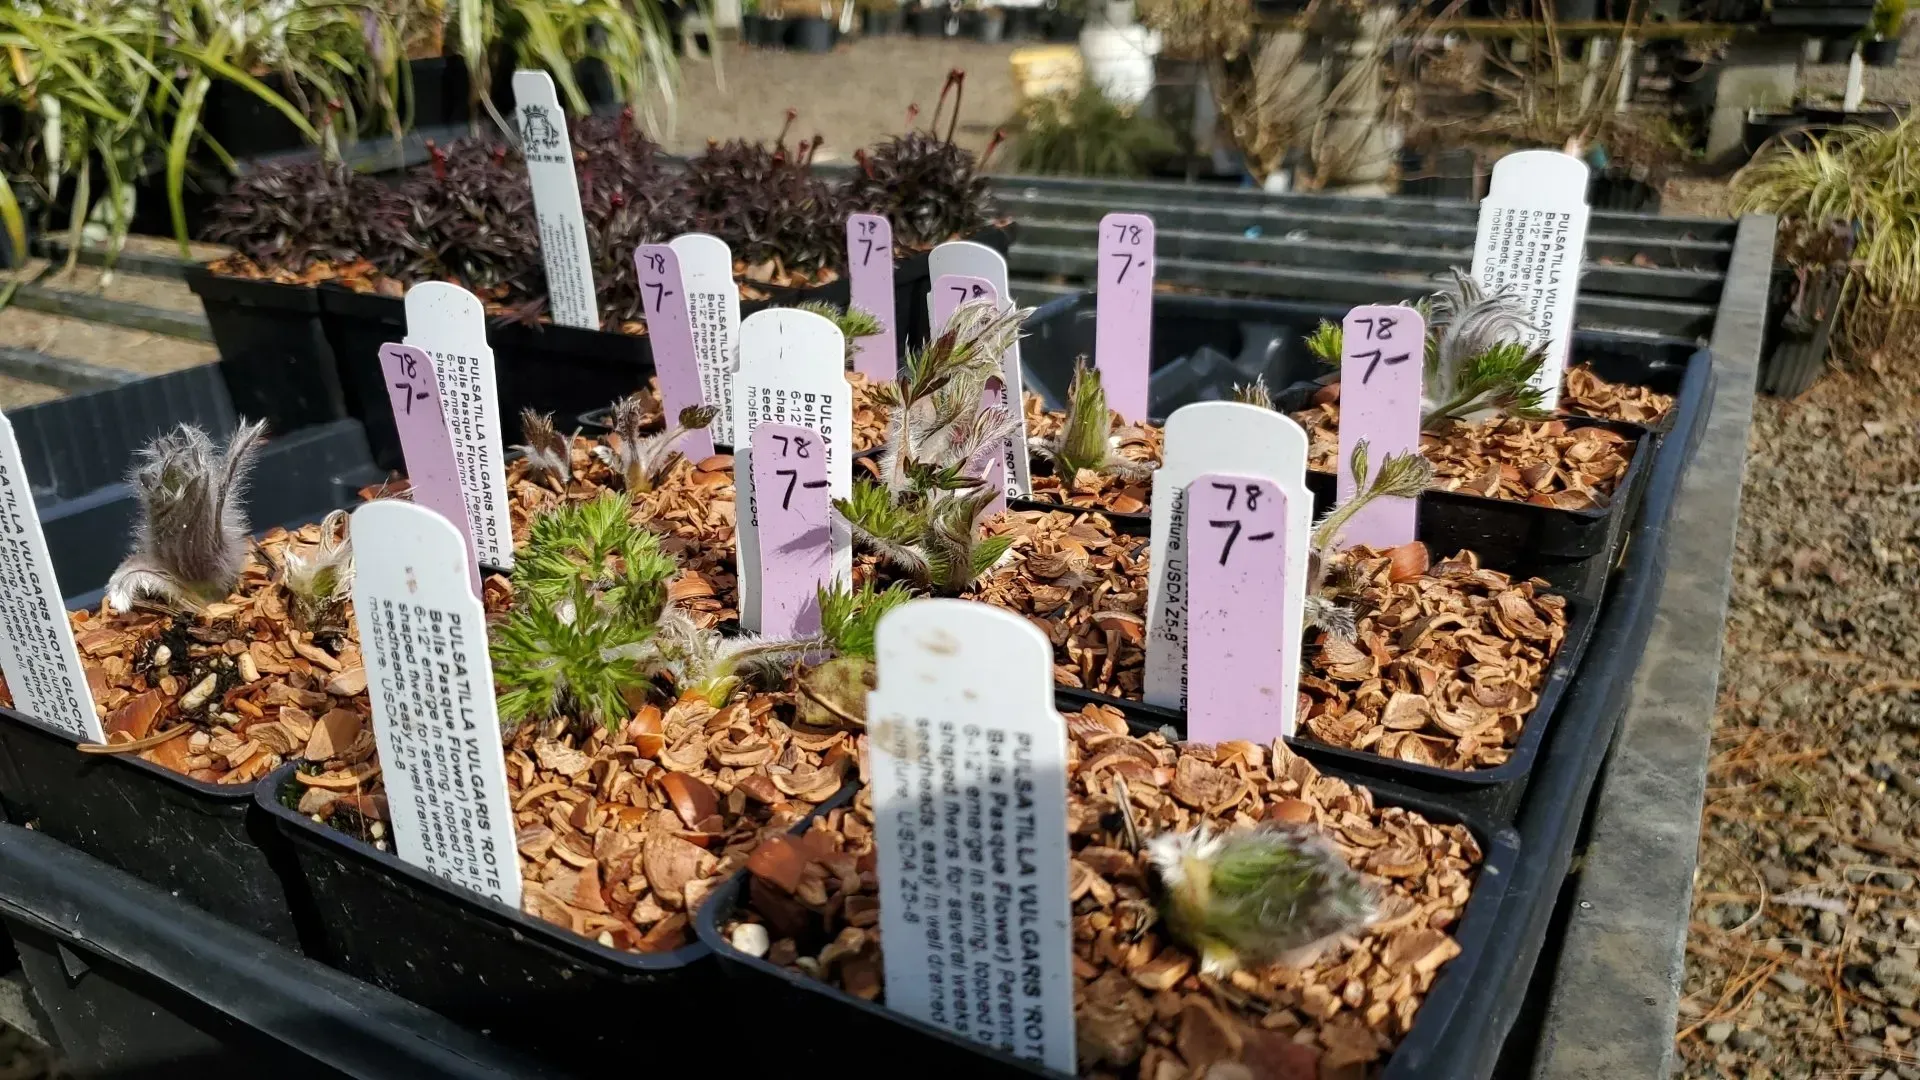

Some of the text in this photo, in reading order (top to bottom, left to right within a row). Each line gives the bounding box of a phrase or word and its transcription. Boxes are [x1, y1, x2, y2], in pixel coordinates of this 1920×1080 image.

[858, 221, 877, 235] 78
[1112, 224, 1142, 245] 78
[1514, 209, 1529, 247] shaped
[1541, 212, 1555, 240] Bells
[643, 254, 664, 274] 78
[1521, 241, 1536, 280] emerge
[1534, 243, 1550, 285] Pasque
[1548, 213, 1570, 284] PULSATILLA
[1482, 257, 1495, 288] USDA
[1494, 269, 1504, 290] eas
[1520, 282, 1530, 292] in
[689, 292, 698, 328] shaped
[707, 293, 716, 321] Bells
[717, 293, 729, 363] PULSATILLA
[1354, 317, 1398, 340] 78
[700, 322, 709, 360] emerge
[709, 324, 717, 364] Pasque
[390, 352, 417, 379] 78
[435, 352, 447, 395] shaped
[457, 355, 468, 388] Bells
[703, 362, 710, 371] in
[450, 389, 461, 435] emerge
[722, 366, 732, 422] VULGARIS
[774, 389, 787, 425] shap
[460, 392, 471, 441] Pasque
[455, 437, 464, 448] in
[469, 357, 485, 440] PULSATILLA
[478, 445, 493, 511] VULGARIS
[486, 515, 498, 553] 'ROTE
[772, 434, 810, 459] 78
[465, 444, 479, 491] Flower)
[1211, 482, 1263, 512] 78
[471, 495, 486, 549] Perennial
[1166, 559, 1181, 603] USDA
[19, 540, 51, 621] VULGARIS
[46, 626, 67, 672] 'ROTE
[1163, 607, 1179, 641] Z5-8
[7, 538, 32, 596] Flower)
[26, 600, 54, 665] Perennial
[48, 668, 68, 713] clumps
[63, 716, 76, 731] of
[398, 603, 417, 664] shaped
[429, 610, 446, 655] Bells
[15, 596, 37, 642] topped
[30, 644, 42, 662] by
[37, 664, 53, 697] hairy
[49, 699, 63, 722] red
[22, 674, 35, 698] sun
[31, 700, 40, 713] to
[25, 655, 47, 708] feathery
[421, 657, 439, 720] emerge
[436, 661, 455, 730] Pasque
[381, 678, 398, 727] USDA
[390, 732, 405, 770] Z5-8
[398, 701, 412, 740] easy
[416, 722, 429, 745] for
[431, 724, 443, 739] in
[406, 745, 417, 758] in
[447, 735, 469, 802] Flower)
[448, 613, 475, 730] PULSATILLA
[465, 738, 490, 829] VULGARIS
[480, 836, 500, 889] 'ROTE
[937, 722, 959, 796] shaped
[987, 730, 1004, 785] Bells
[409, 763, 424, 792] well
[421, 749, 440, 807] several
[415, 794, 434, 852] drained
[443, 800, 462, 852] topped
[962, 786, 983, 863] emerge
[1012, 733, 1036, 876] PULSATILLA
[459, 806, 482, 881] Perennial
[897, 811, 917, 872] USDA
[988, 792, 1008, 875] Pasque
[452, 856, 464, 874] by
[919, 840, 938, 887] easy
[946, 866, 964, 895] for
[969, 868, 985, 885] in
[924, 893, 940, 909] in
[992, 881, 1014, 963] Flower)
[925, 915, 944, 951] well
[947, 898, 968, 969] several
[1018, 884, 1041, 996] VULGARIS
[927, 954, 948, 1024] drained
[972, 961, 992, 1026] topped
